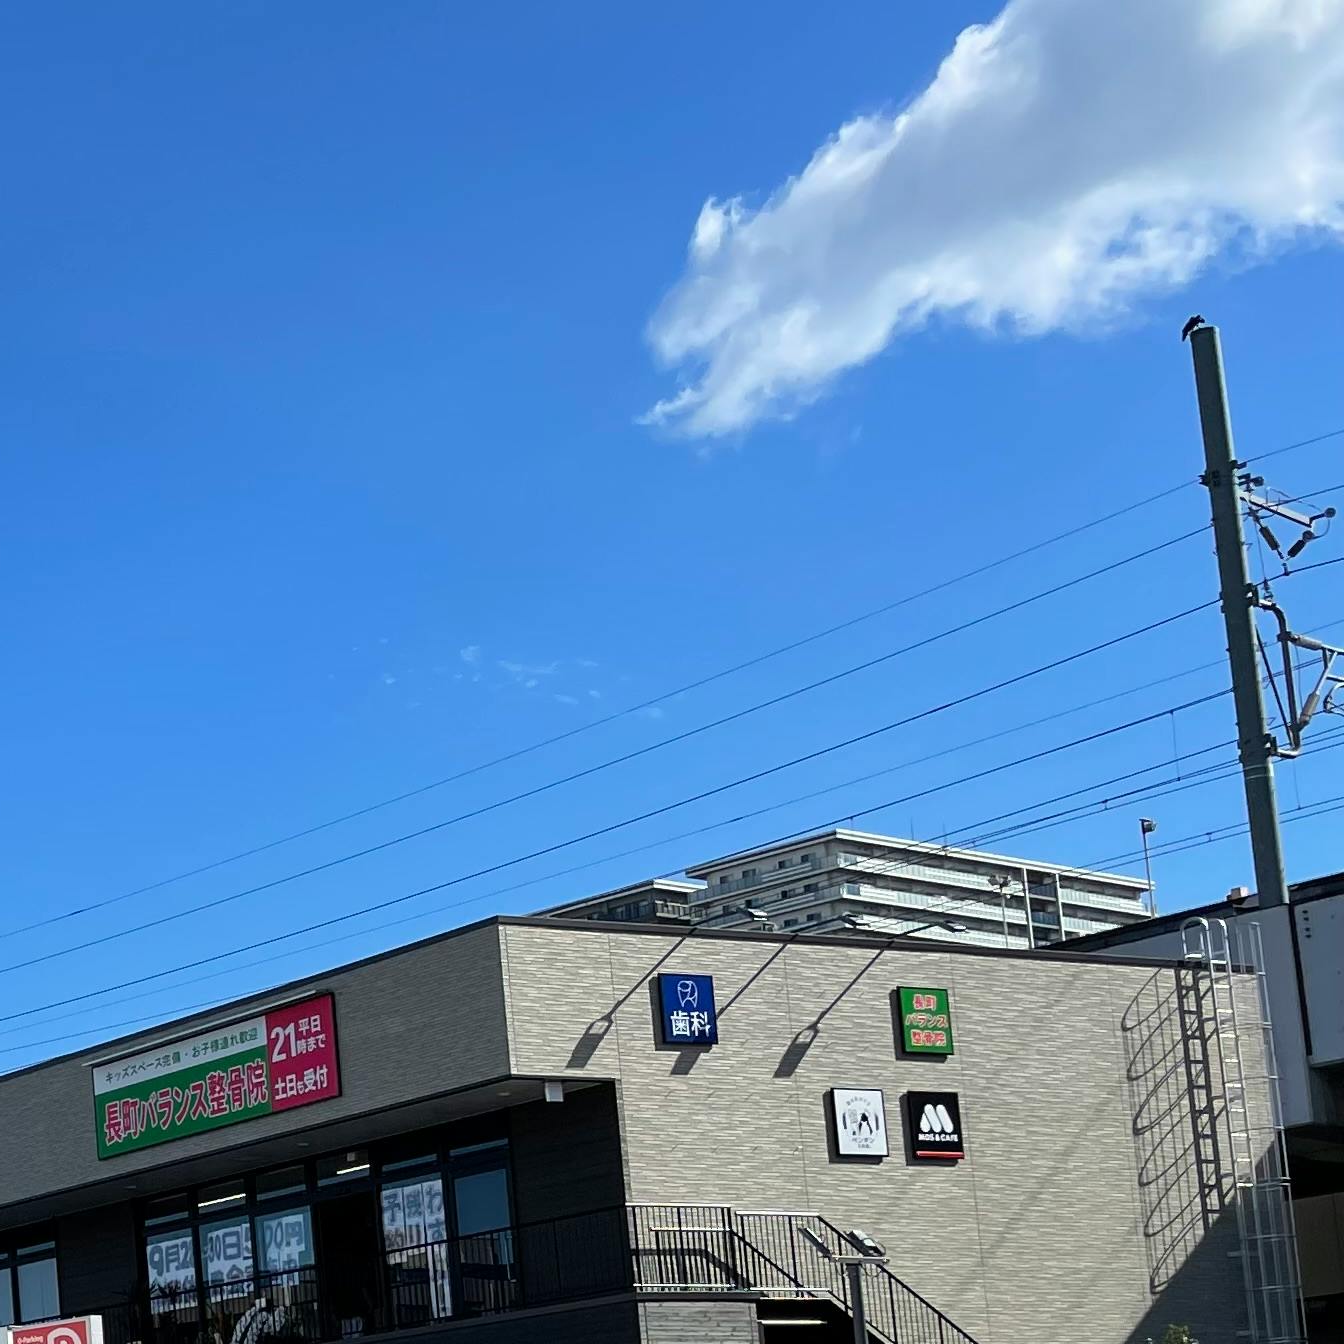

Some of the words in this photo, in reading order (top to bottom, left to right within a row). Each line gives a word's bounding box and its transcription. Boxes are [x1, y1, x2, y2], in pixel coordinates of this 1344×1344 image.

[270, 1022, 298, 1064] 21
[298, 1014, 321, 1033] 平日
[670, 1010, 712, 1037] 歯科
[104, 1060, 269, 1147] 長町バランス整骨院
[275, 1064, 329, 1101] 土日も受付
